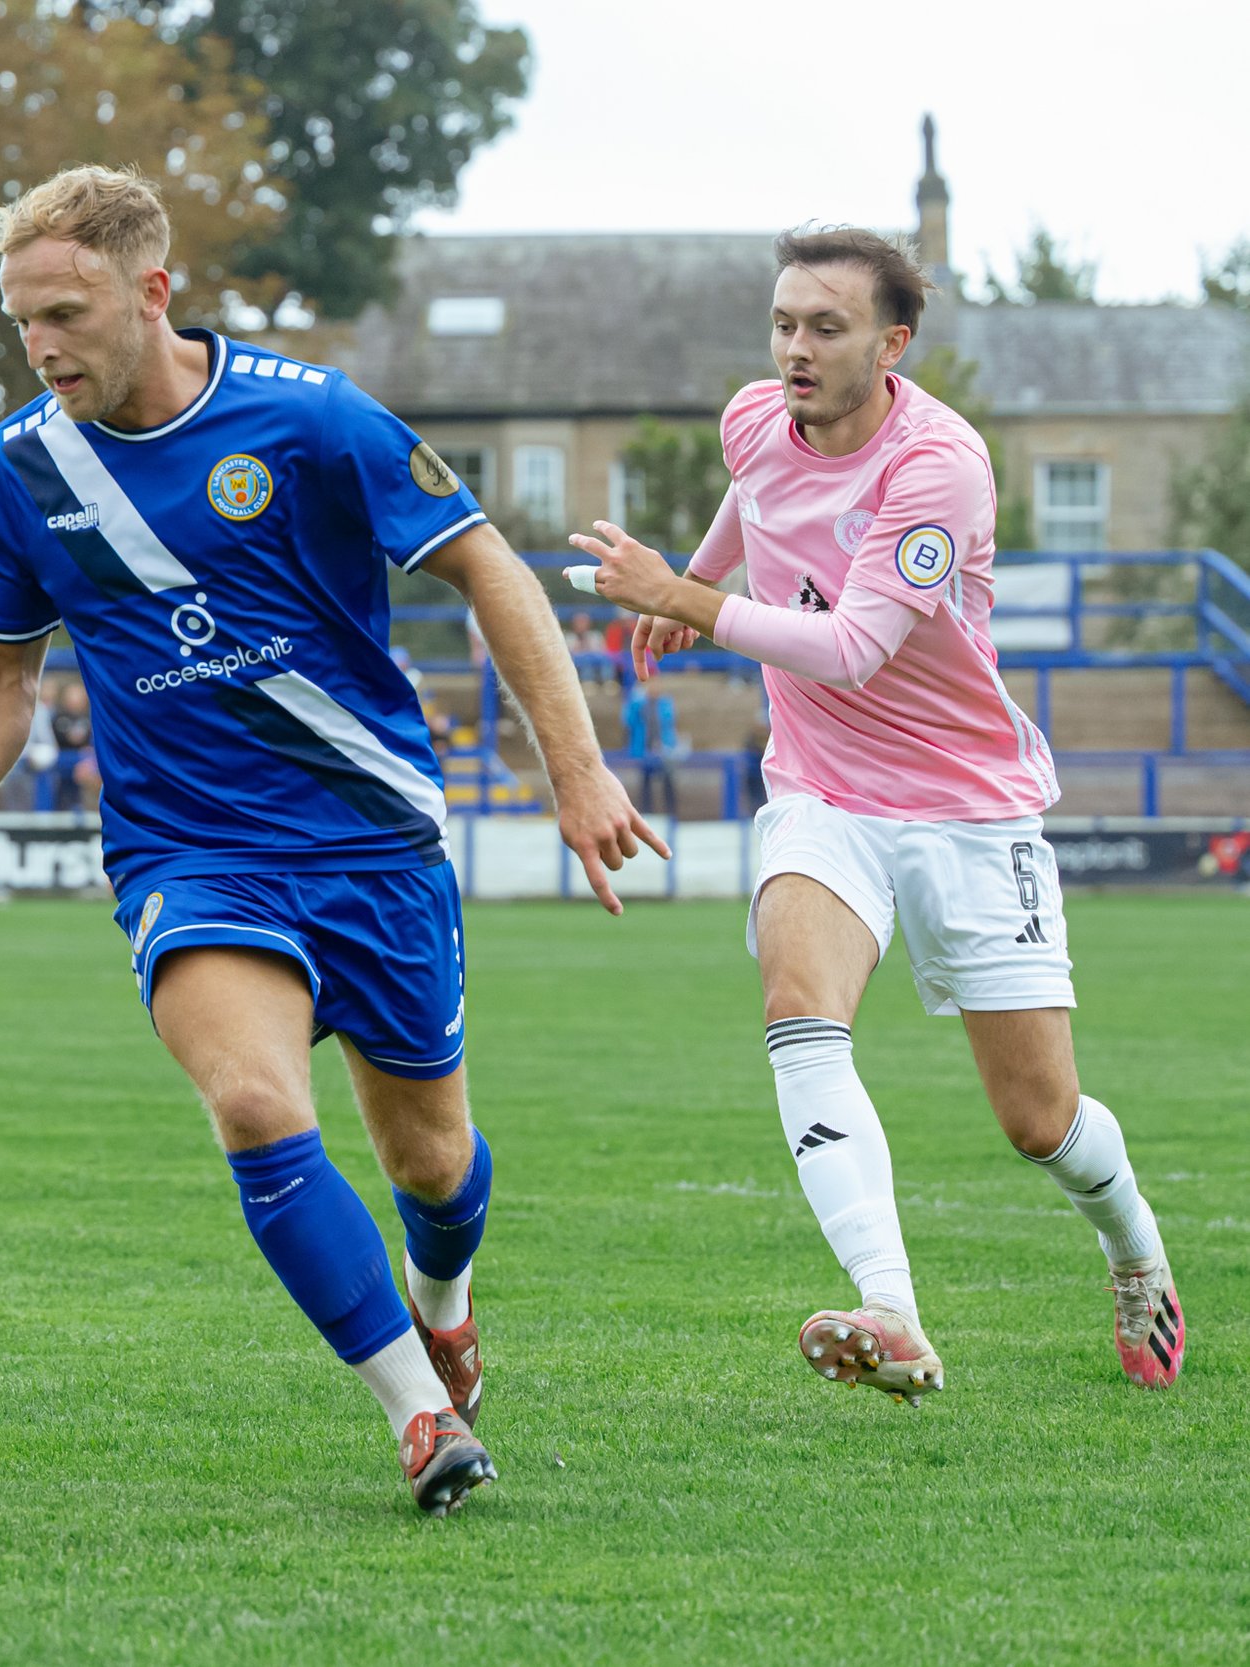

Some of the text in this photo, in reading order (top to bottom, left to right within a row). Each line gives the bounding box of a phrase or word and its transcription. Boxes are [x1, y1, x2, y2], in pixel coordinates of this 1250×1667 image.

[213, 459, 265, 487] LANCASTER CITY
[46, 503, 98, 531] capelli
[215, 490, 268, 516] FOOTBALL CLUB
[912, 543, 939, 570] B
[135, 635, 293, 694] accessplanit
[1010, 842, 1038, 910] 6
